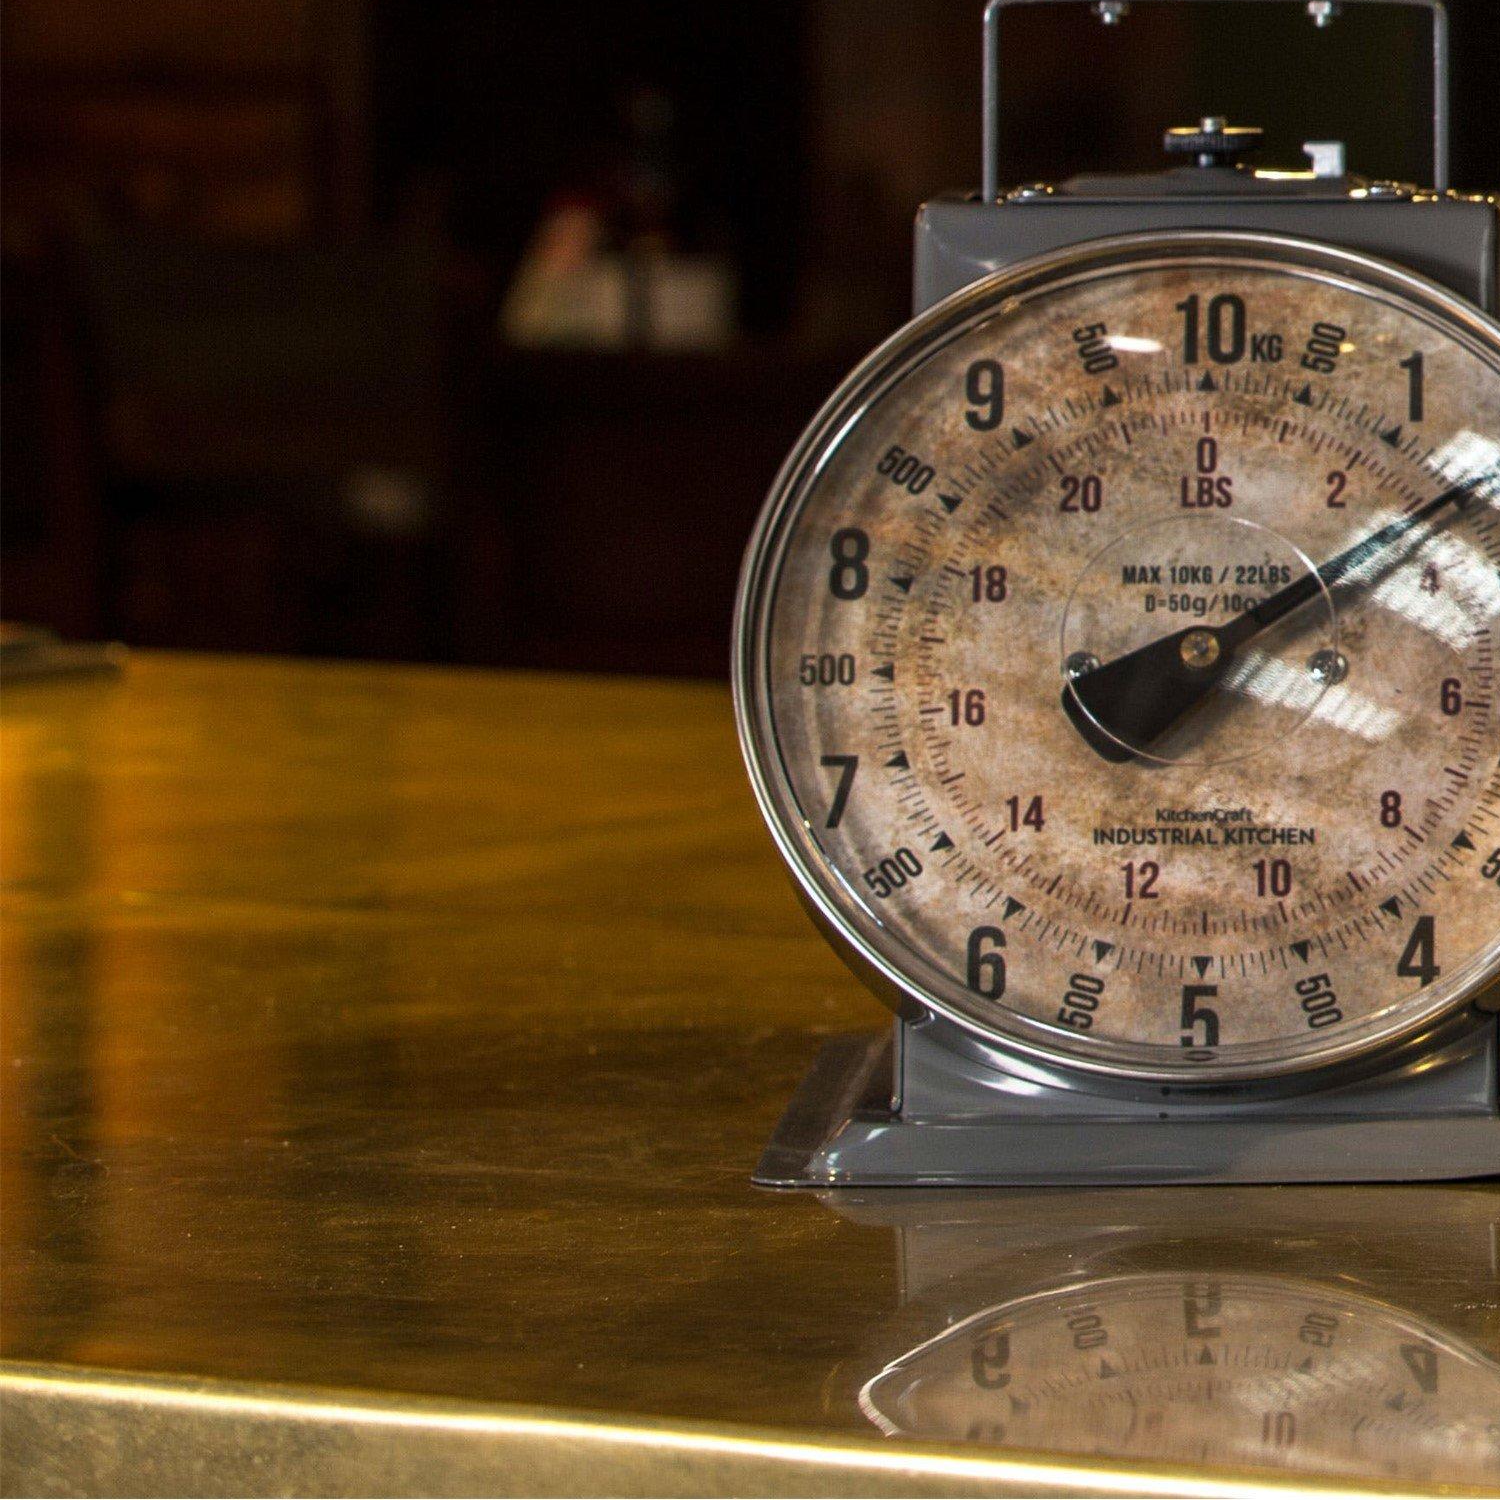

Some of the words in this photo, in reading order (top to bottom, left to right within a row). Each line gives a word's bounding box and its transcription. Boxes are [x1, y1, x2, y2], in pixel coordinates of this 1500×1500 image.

[1072, 321, 1119, 375] 500
[1176, 293, 1246, 365] 10
[1250, 334, 1283, 363] KG
[1302, 321, 1346, 374] 500
[964, 359, 1005, 432] 9
[1401, 350, 1424, 422] 1
[876, 444, 936, 495] 500
[1197, 437, 1217, 474] 0
[1059, 475, 1102, 513] 20
[1181, 476, 1232, 508] LBS
[1326, 470, 1347, 508] 2
[829, 527, 870, 601] 8
[968, 565, 1008, 602] 18
[1122, 565, 1161, 585] MAX
[1170, 565, 1213, 585] 10KG
[1219, 566, 1230, 584] /
[1235, 565, 1291, 585] 22LBS
[799, 653, 857, 687] 500
[947, 689, 986, 727] 16
[1440, 677, 1462, 716] 6
[819, 754, 859, 829] 7
[1380, 790, 1402, 828] 8
[1006, 795, 1045, 833] 14
[1155, 807, 1253, 825] KitchenCraft
[1093, 827, 1219, 846] INDUSTRIAL
[1224, 827, 1316, 846] KITCHEN
[863, 846, 923, 899] 500
[1120, 861, 1161, 899] 12
[1252, 858, 1292, 897] 10
[966, 925, 1007, 1000] 6
[1396, 915, 1440, 988] 4
[1057, 972, 1106, 1030] 500
[1179, 984, 1220, 1047] 5
[1294, 972, 1343, 1030] 500
